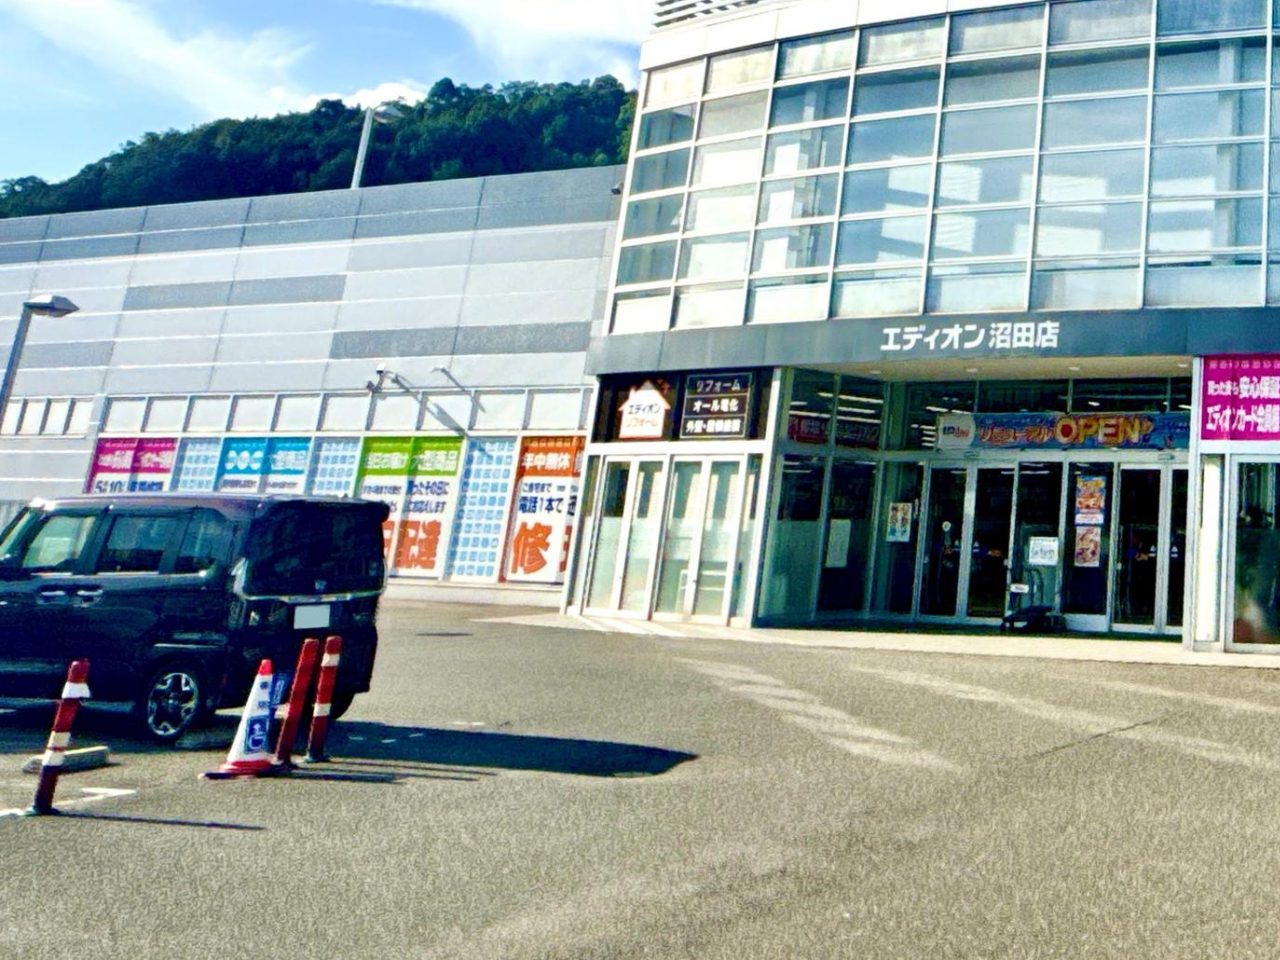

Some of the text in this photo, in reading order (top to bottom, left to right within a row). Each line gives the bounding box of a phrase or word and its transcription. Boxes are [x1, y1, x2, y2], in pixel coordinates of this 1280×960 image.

[696, 379, 741, 393] リフォーム
[627, 402, 661, 415] エディオン
[693, 398, 739, 413] オール電化
